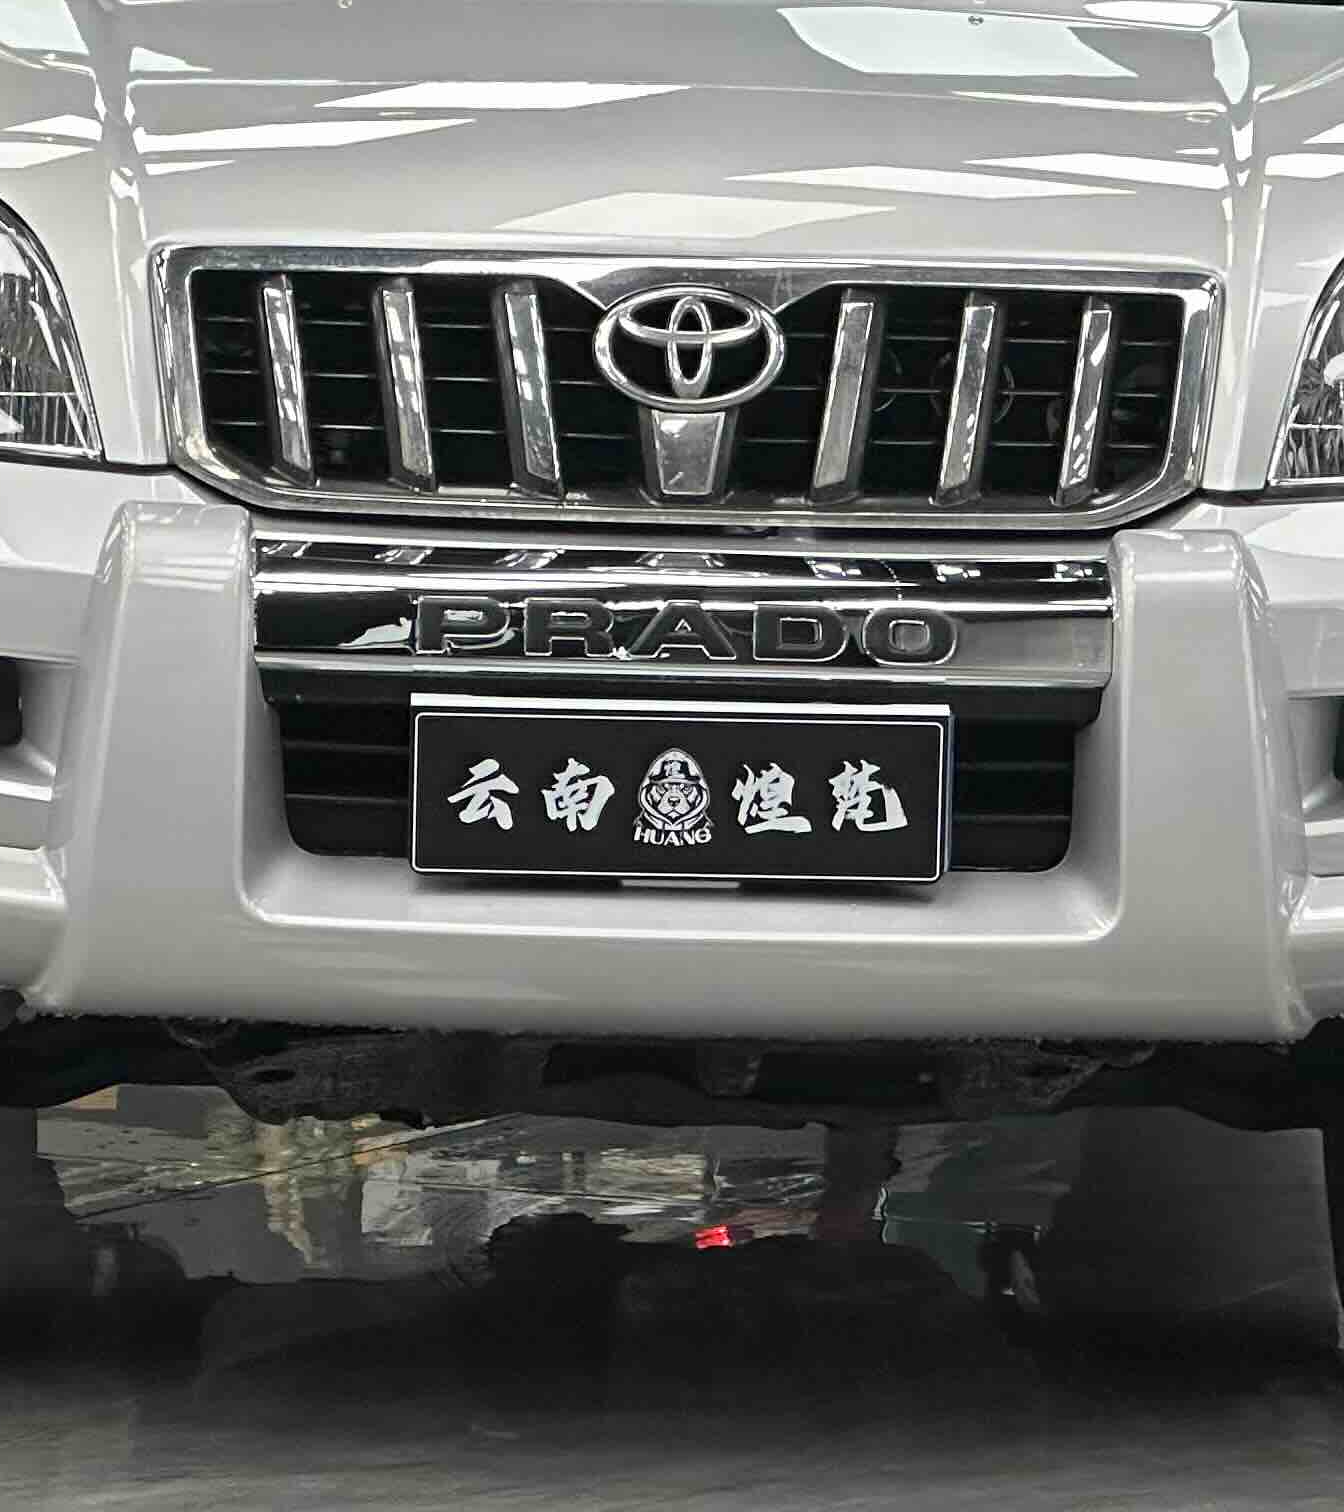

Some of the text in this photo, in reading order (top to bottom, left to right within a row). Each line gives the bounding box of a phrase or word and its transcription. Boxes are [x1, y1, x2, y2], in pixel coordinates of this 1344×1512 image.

[415, 595, 957, 666] PRADO
[447, 758, 615, 832] 云南
[633, 826, 713, 846] HUANG
